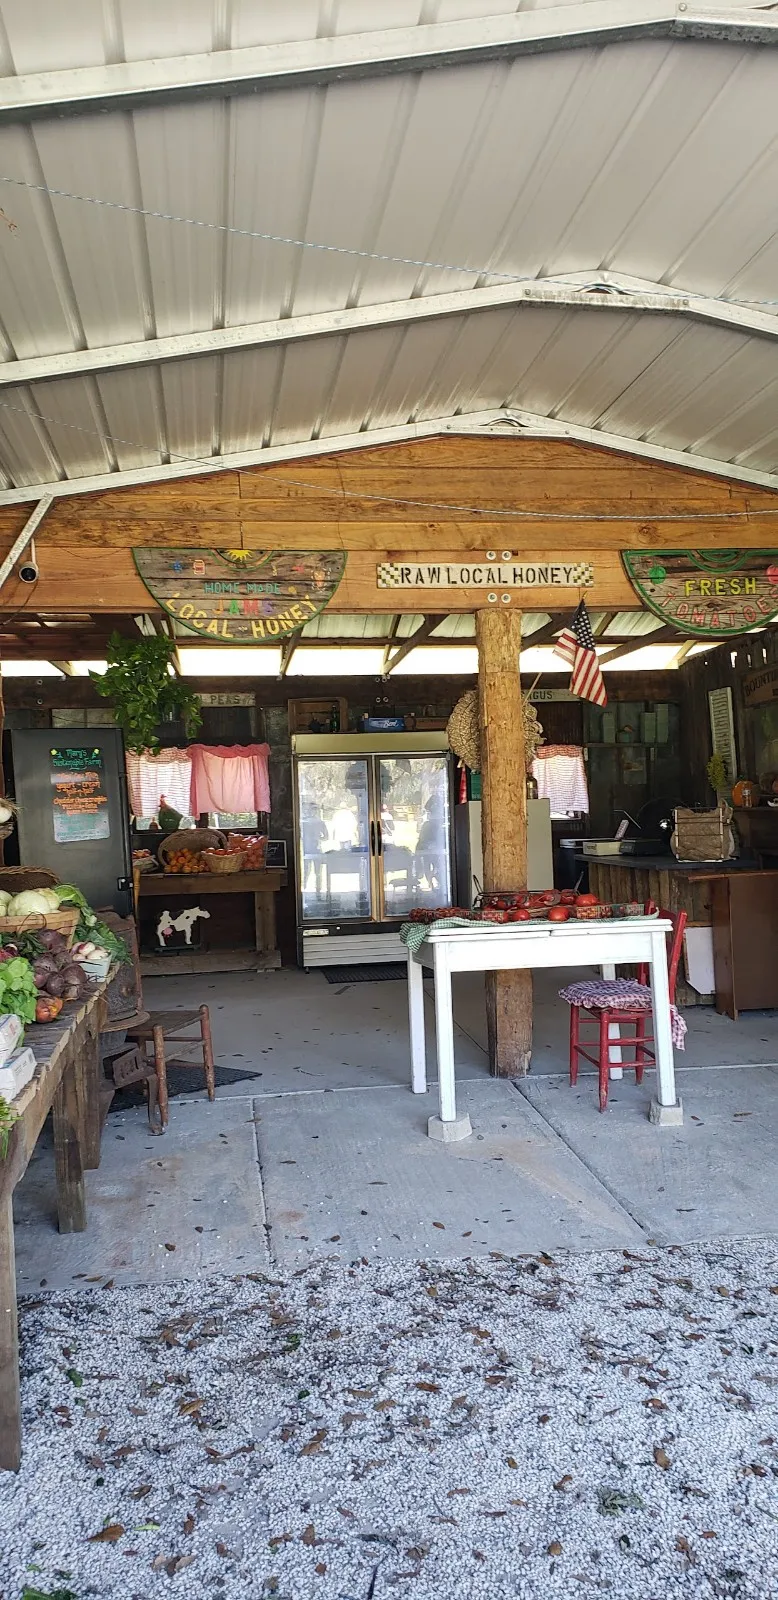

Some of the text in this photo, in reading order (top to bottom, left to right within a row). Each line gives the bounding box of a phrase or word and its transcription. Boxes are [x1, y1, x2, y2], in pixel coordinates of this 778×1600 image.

[400, 567, 573, 584] RAW LOCAL HONEY
[204, 582, 281, 595] HOME MADE
[685, 577, 757, 597] FRESH
[212, 597, 275, 615] JAMS
[165, 592, 318, 639] LOCAL HONEY
[210, 694, 240, 705] PEAS
